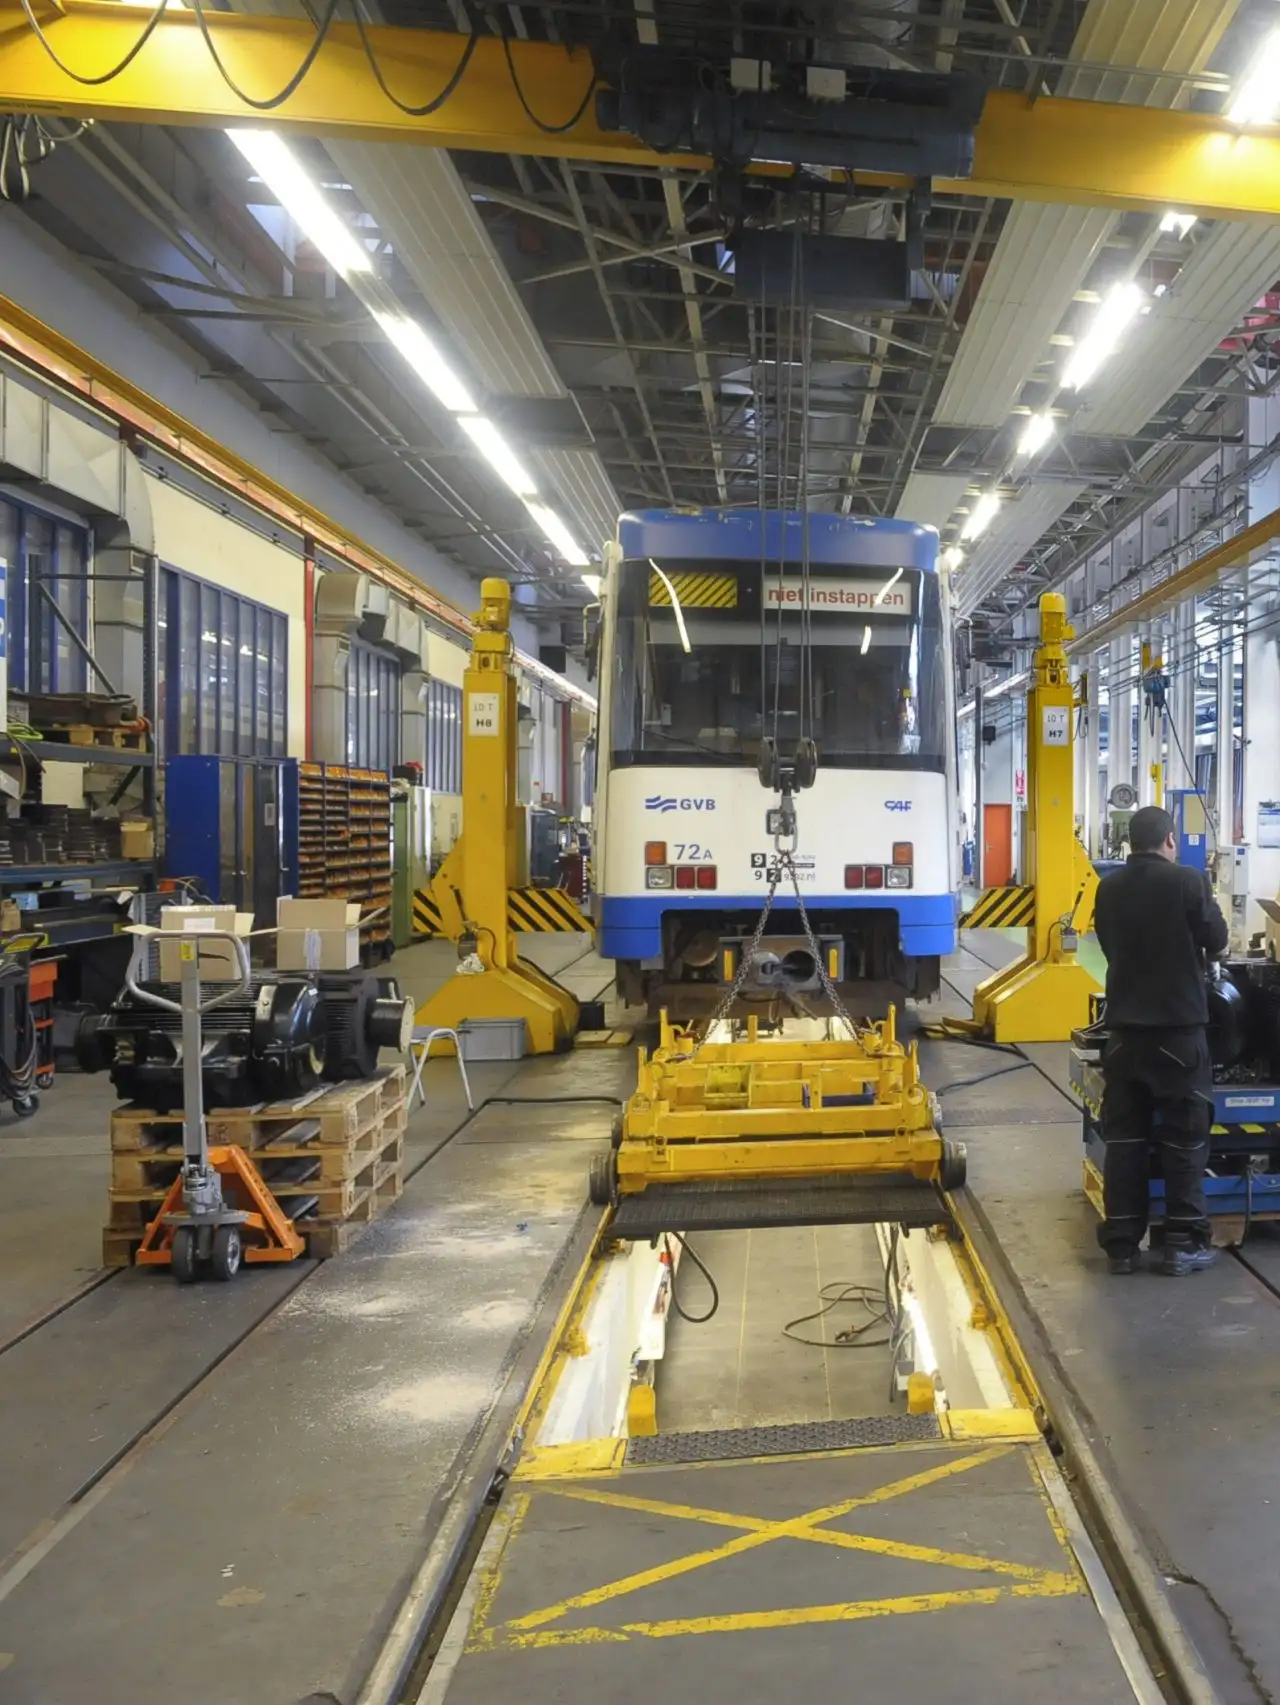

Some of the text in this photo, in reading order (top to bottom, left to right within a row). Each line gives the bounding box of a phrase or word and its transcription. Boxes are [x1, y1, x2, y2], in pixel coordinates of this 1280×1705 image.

[768, 586, 904, 609] niet instappen
[1049, 730, 1063, 738] H7
[680, 798, 716, 811] GVB
[884, 800, 912, 811] CAF
[673, 843, 713, 861] 72A
